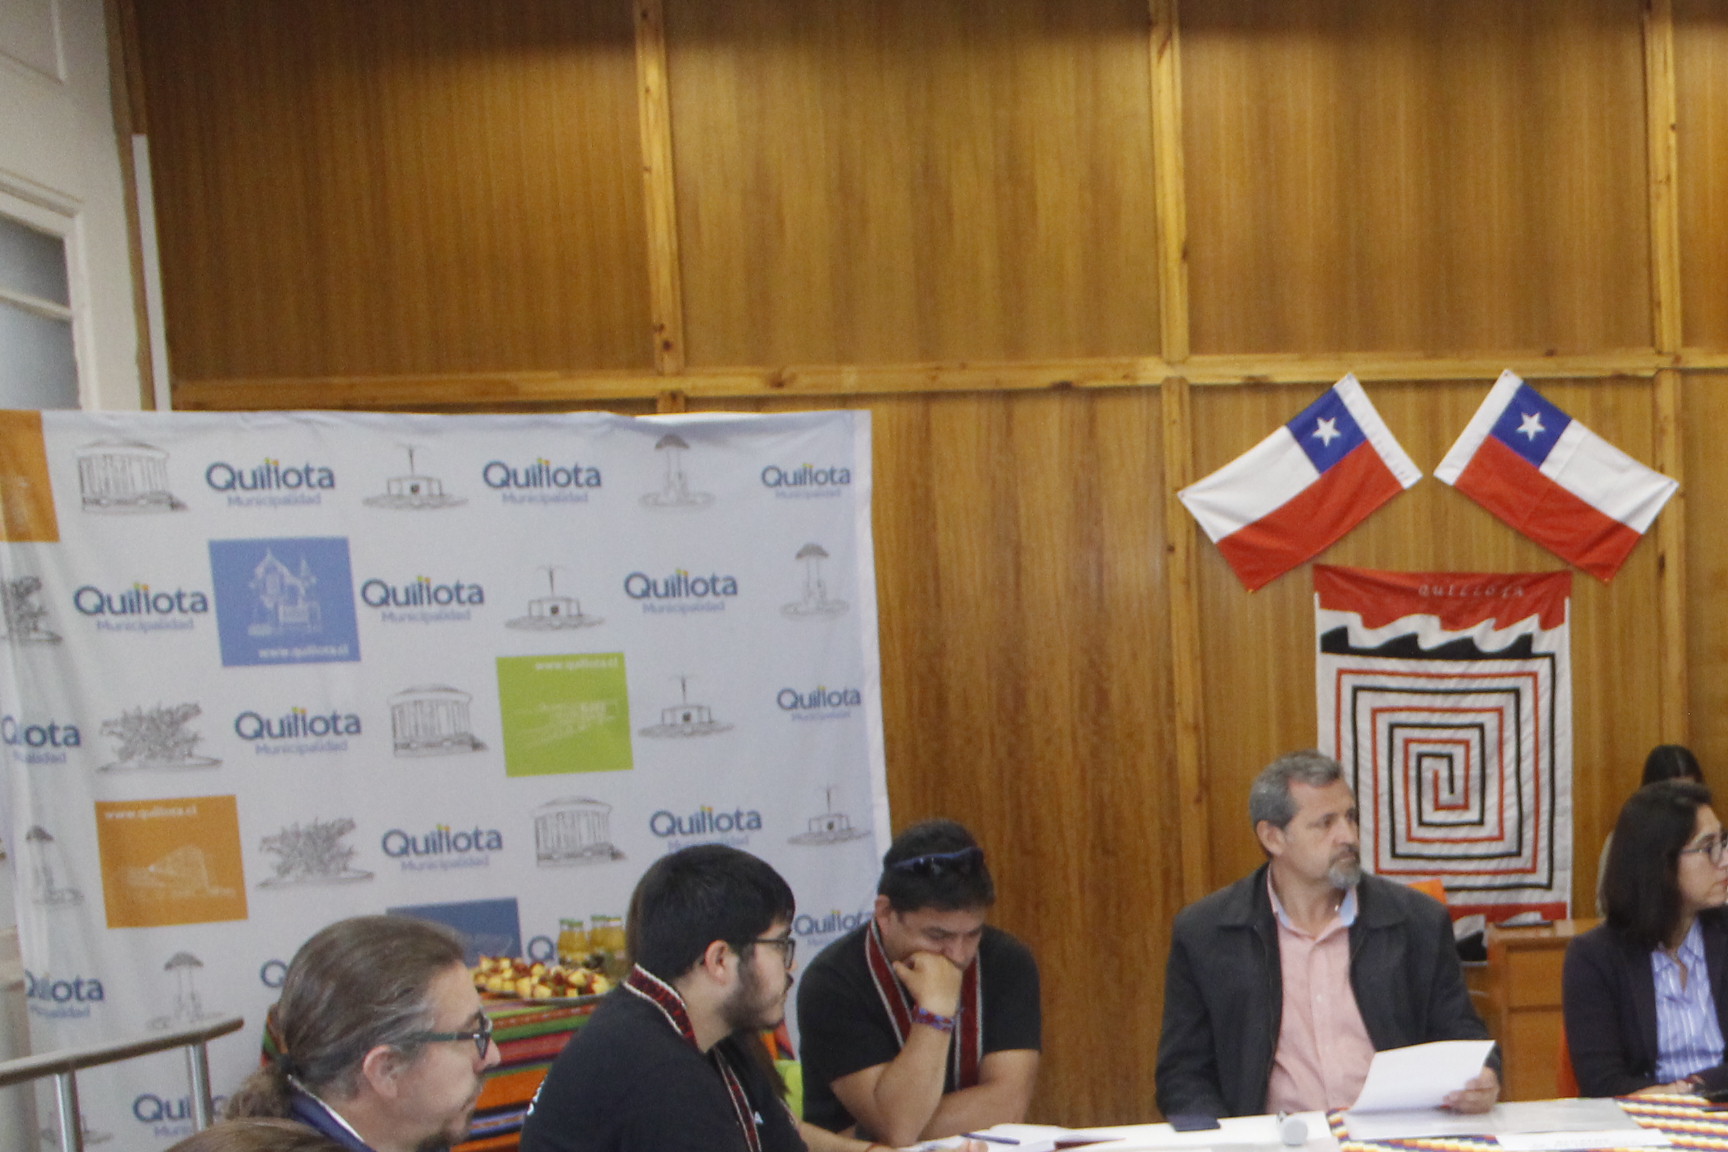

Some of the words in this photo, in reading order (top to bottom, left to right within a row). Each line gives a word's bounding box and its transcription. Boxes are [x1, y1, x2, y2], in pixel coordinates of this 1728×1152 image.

[206, 458, 335, 491] Quillota
[483, 458, 601, 489] Quillota
[761, 463, 851, 487] Quillota
[73, 583, 208, 616] Quillota
[360, 575, 485, 607] Quillota
[624, 569, 738, 599] Quillota
[777, 685, 861, 711] Quillota
[234, 707, 361, 741] Quillota
[650, 806, 762, 837] Quillota
[382, 824, 503, 859] Quillota
